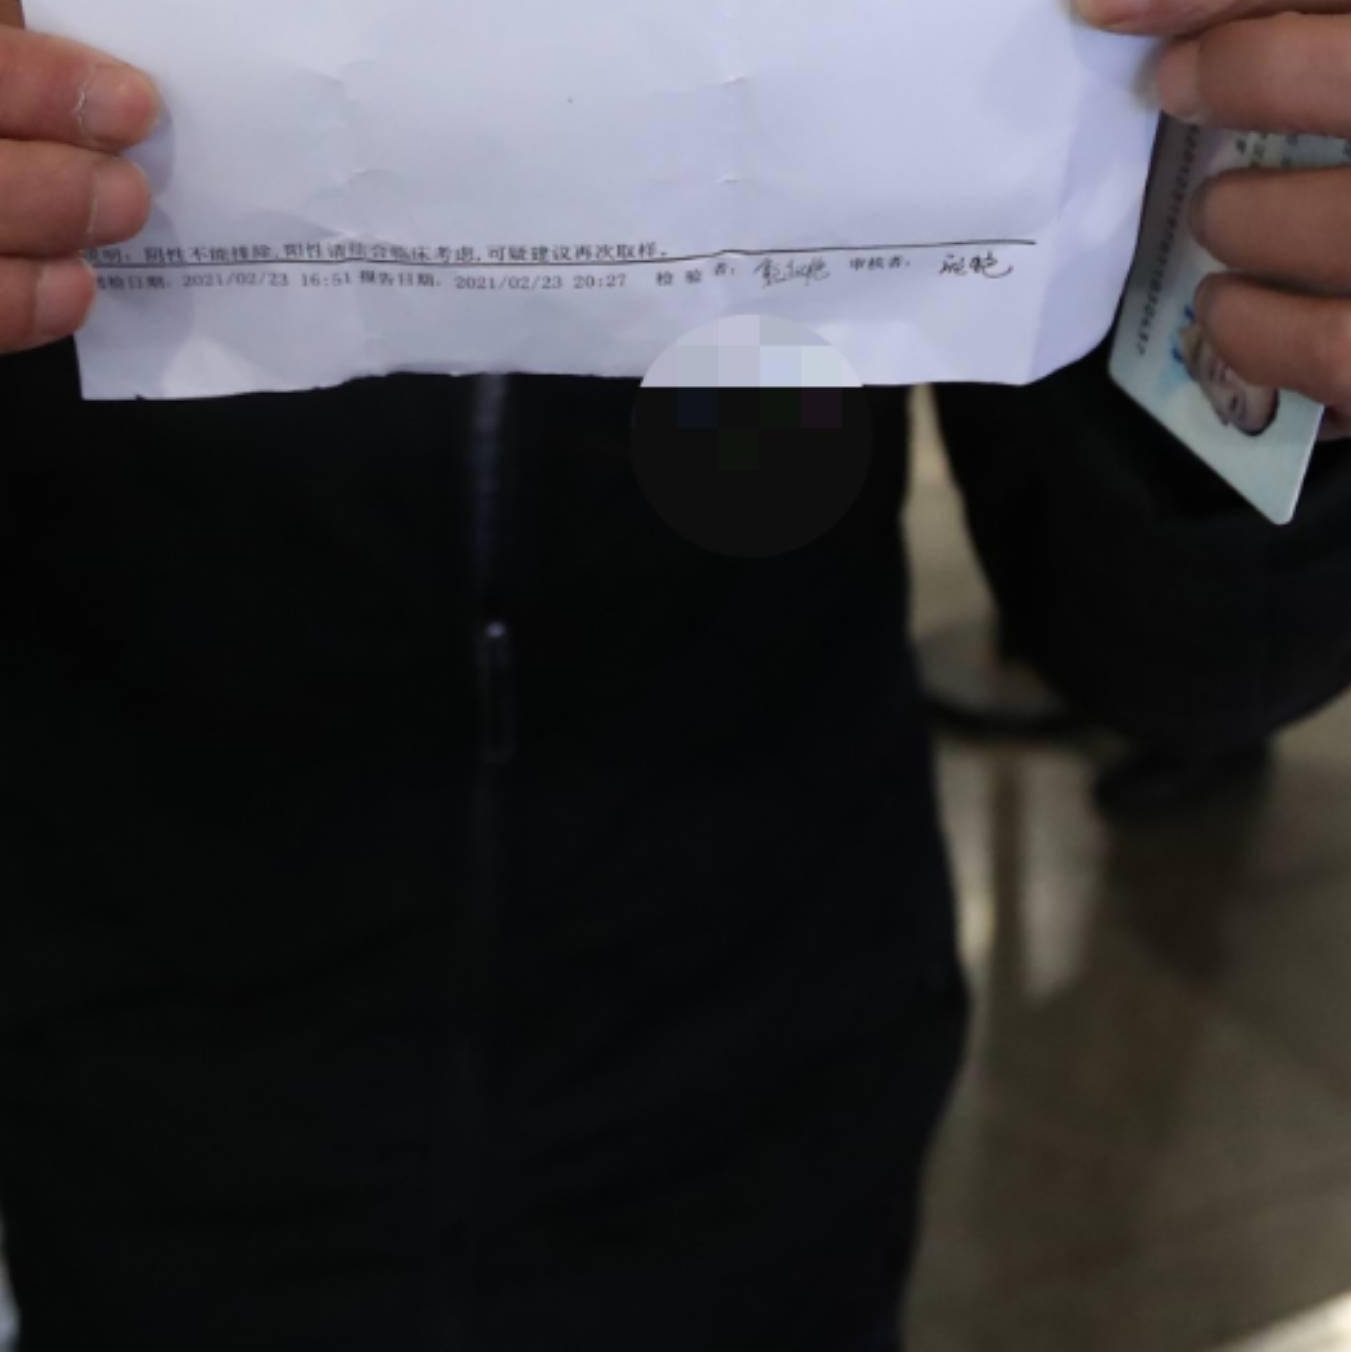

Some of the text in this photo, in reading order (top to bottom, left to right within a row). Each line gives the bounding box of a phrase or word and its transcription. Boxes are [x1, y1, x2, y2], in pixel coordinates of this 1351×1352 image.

[182, 271, 289, 288] 2021/02/23
[300, 271, 351, 288] 16:51
[455, 273, 564, 290] 2021/02/23
[572, 273, 627, 290] 20:27
